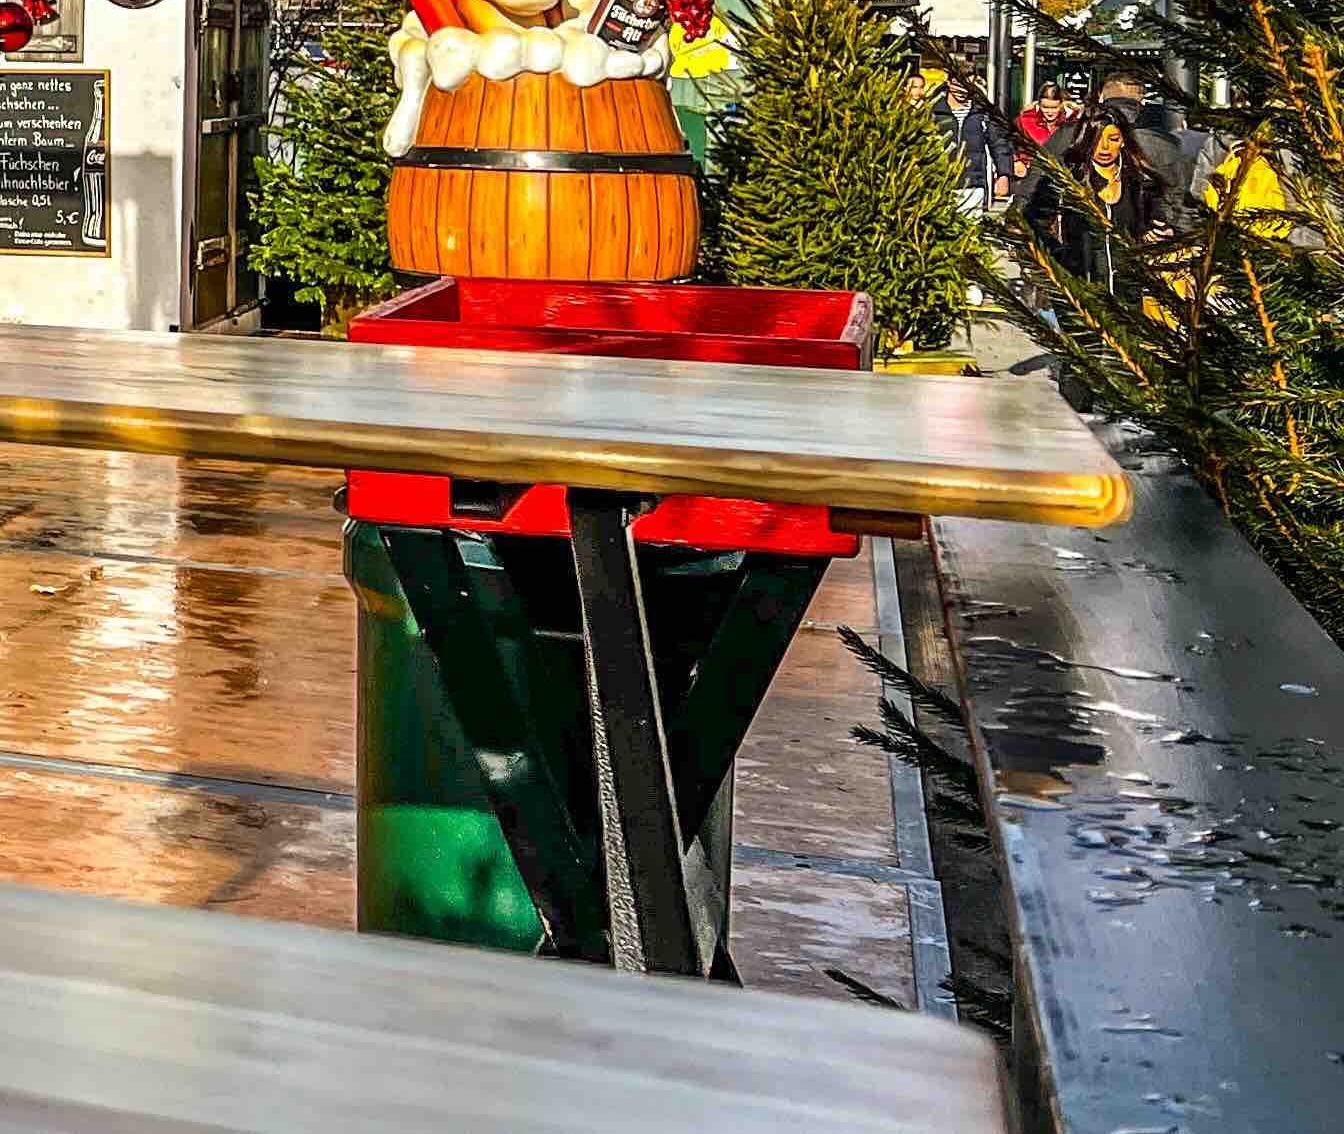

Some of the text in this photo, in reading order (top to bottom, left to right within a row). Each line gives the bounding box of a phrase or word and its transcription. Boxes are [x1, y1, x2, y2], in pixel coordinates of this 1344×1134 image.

[10, 81, 33, 97] ganz
[38, 78, 72, 92] nettes
[17, 115, 81, 130] verschenken
